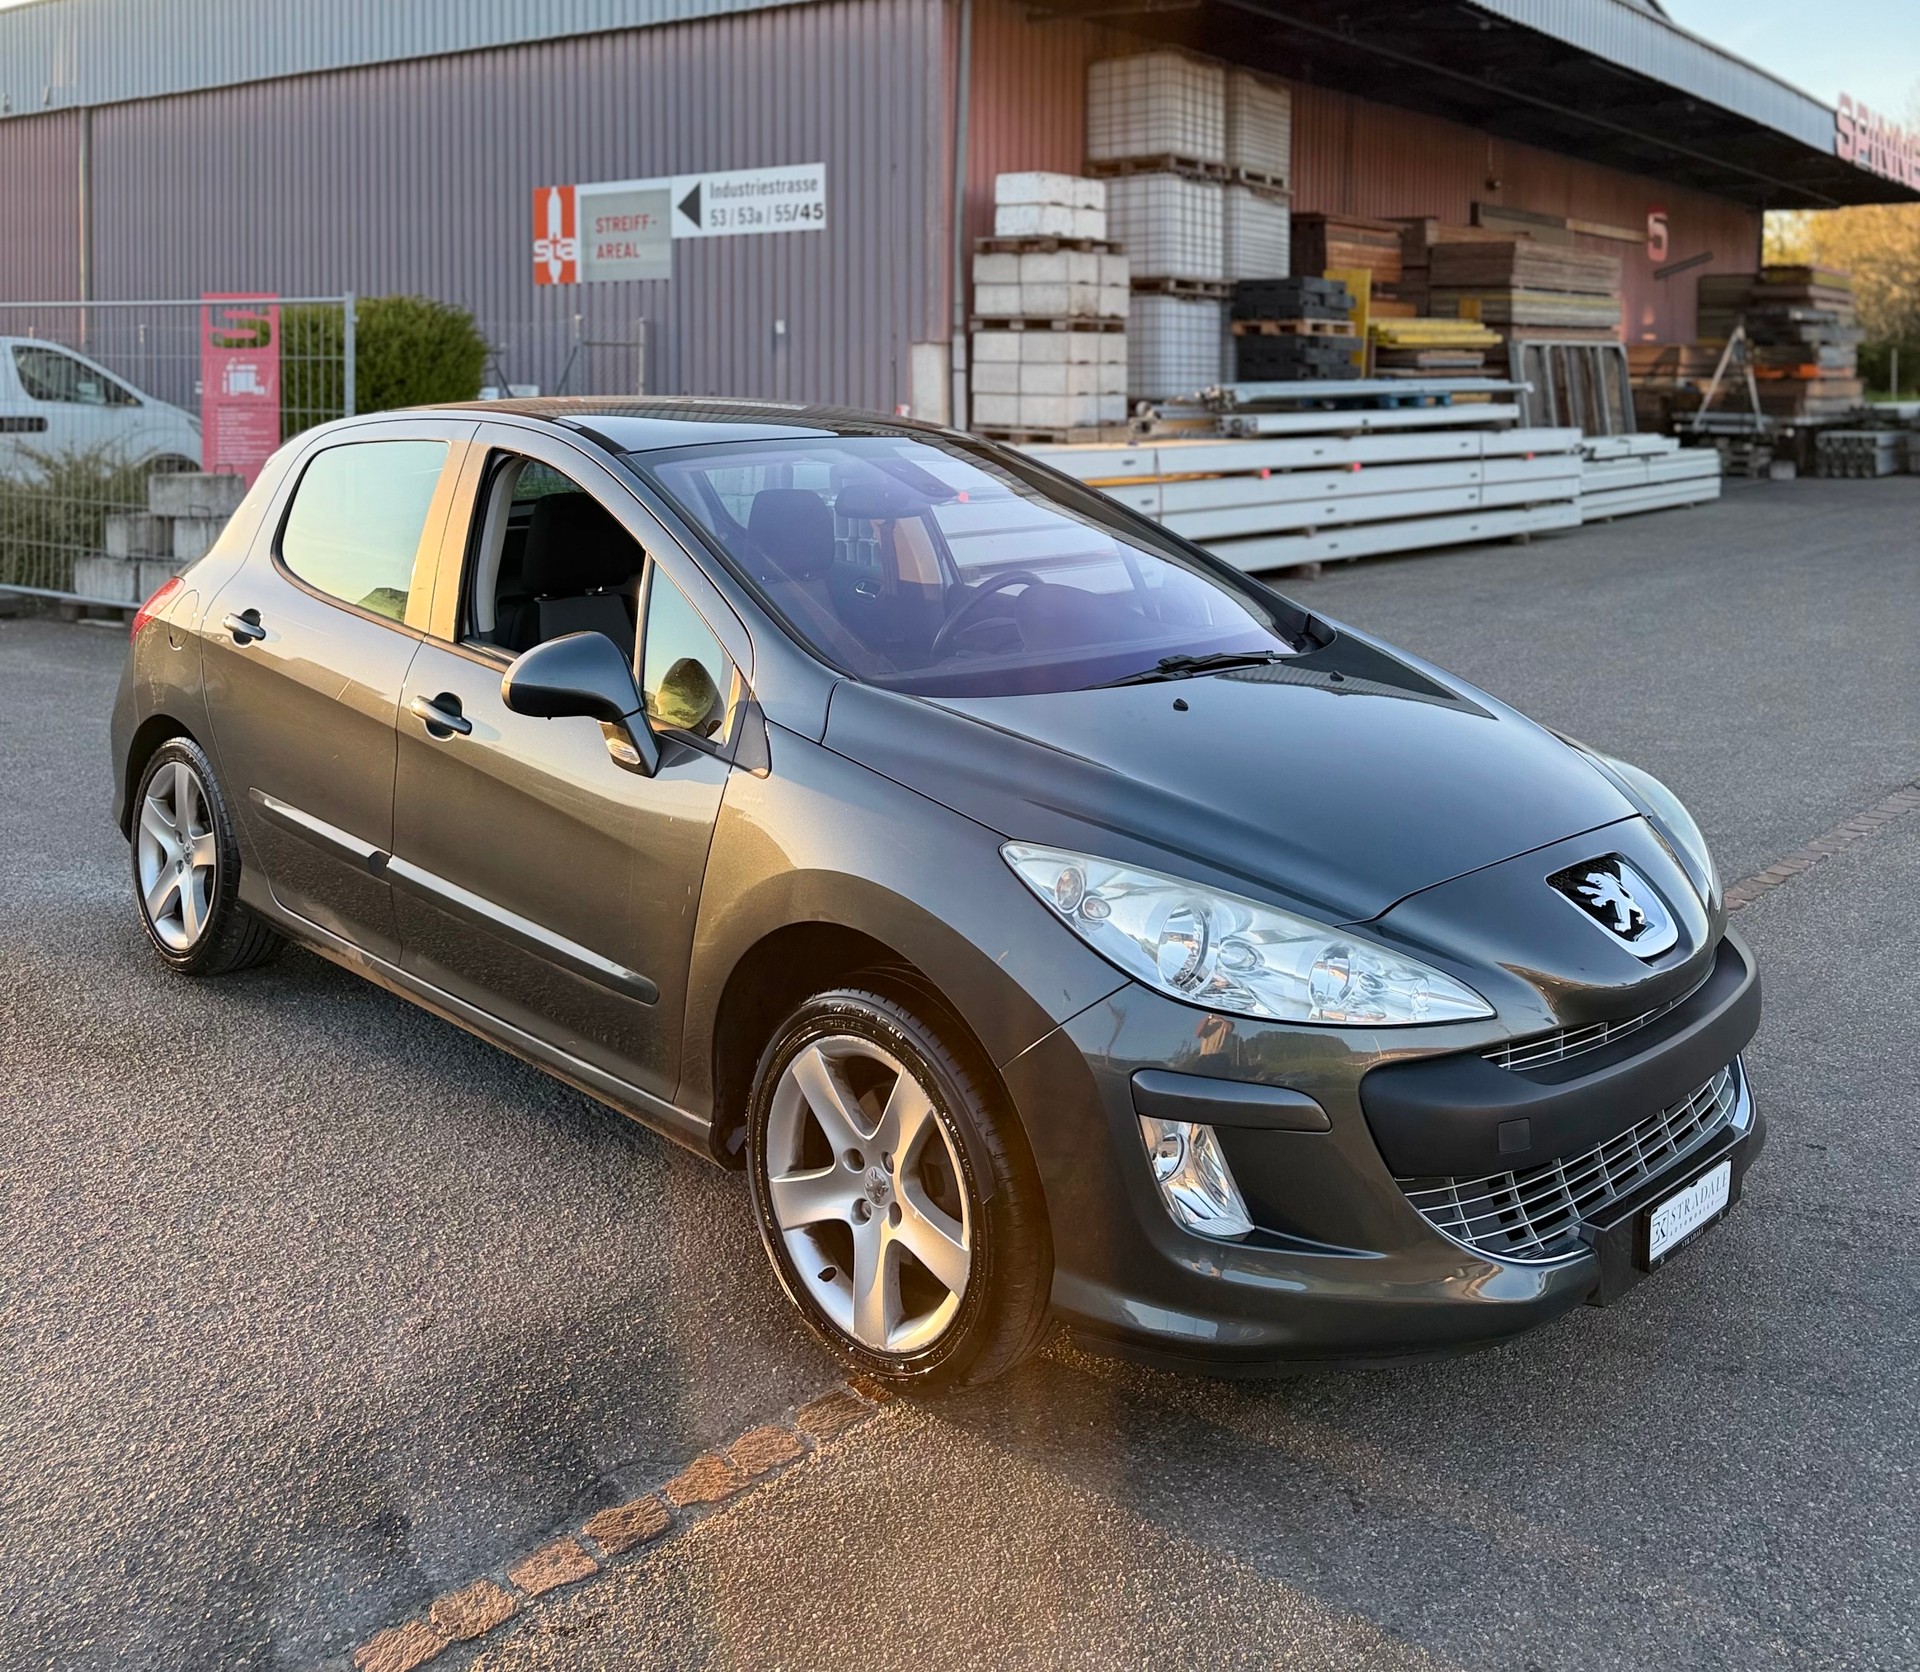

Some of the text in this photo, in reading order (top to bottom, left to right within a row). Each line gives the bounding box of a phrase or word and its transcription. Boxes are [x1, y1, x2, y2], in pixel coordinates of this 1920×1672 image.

[710, 178, 818, 200] Industriestrasse
[595, 213, 658, 234] STREIFF-
[710, 207, 727, 227] 53
[738, 206, 763, 225] 53a
[596, 241, 641, 260] AREAL
[1670, 1170, 1728, 1225] STRADALE
